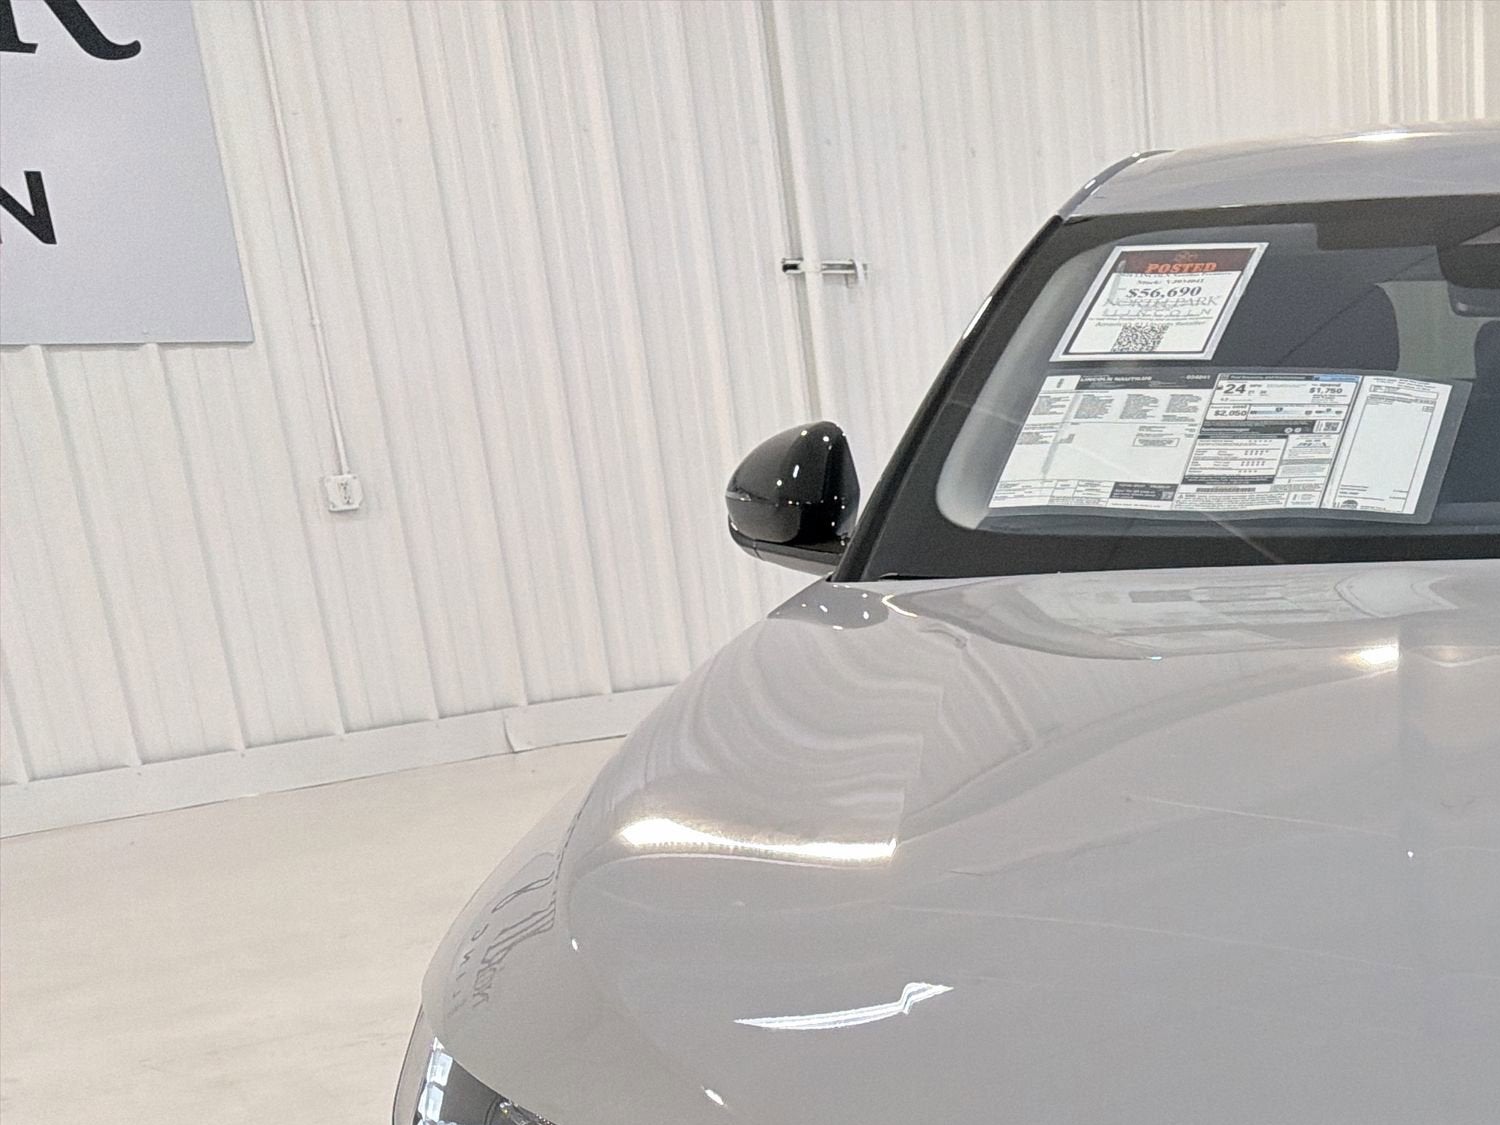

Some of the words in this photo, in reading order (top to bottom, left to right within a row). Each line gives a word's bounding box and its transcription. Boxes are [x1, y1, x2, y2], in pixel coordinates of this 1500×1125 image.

[1145, 262, 1217, 274] POSTED
[1126, 286, 1203, 299] $56,690
[1223, 383, 1247, 394] 24
